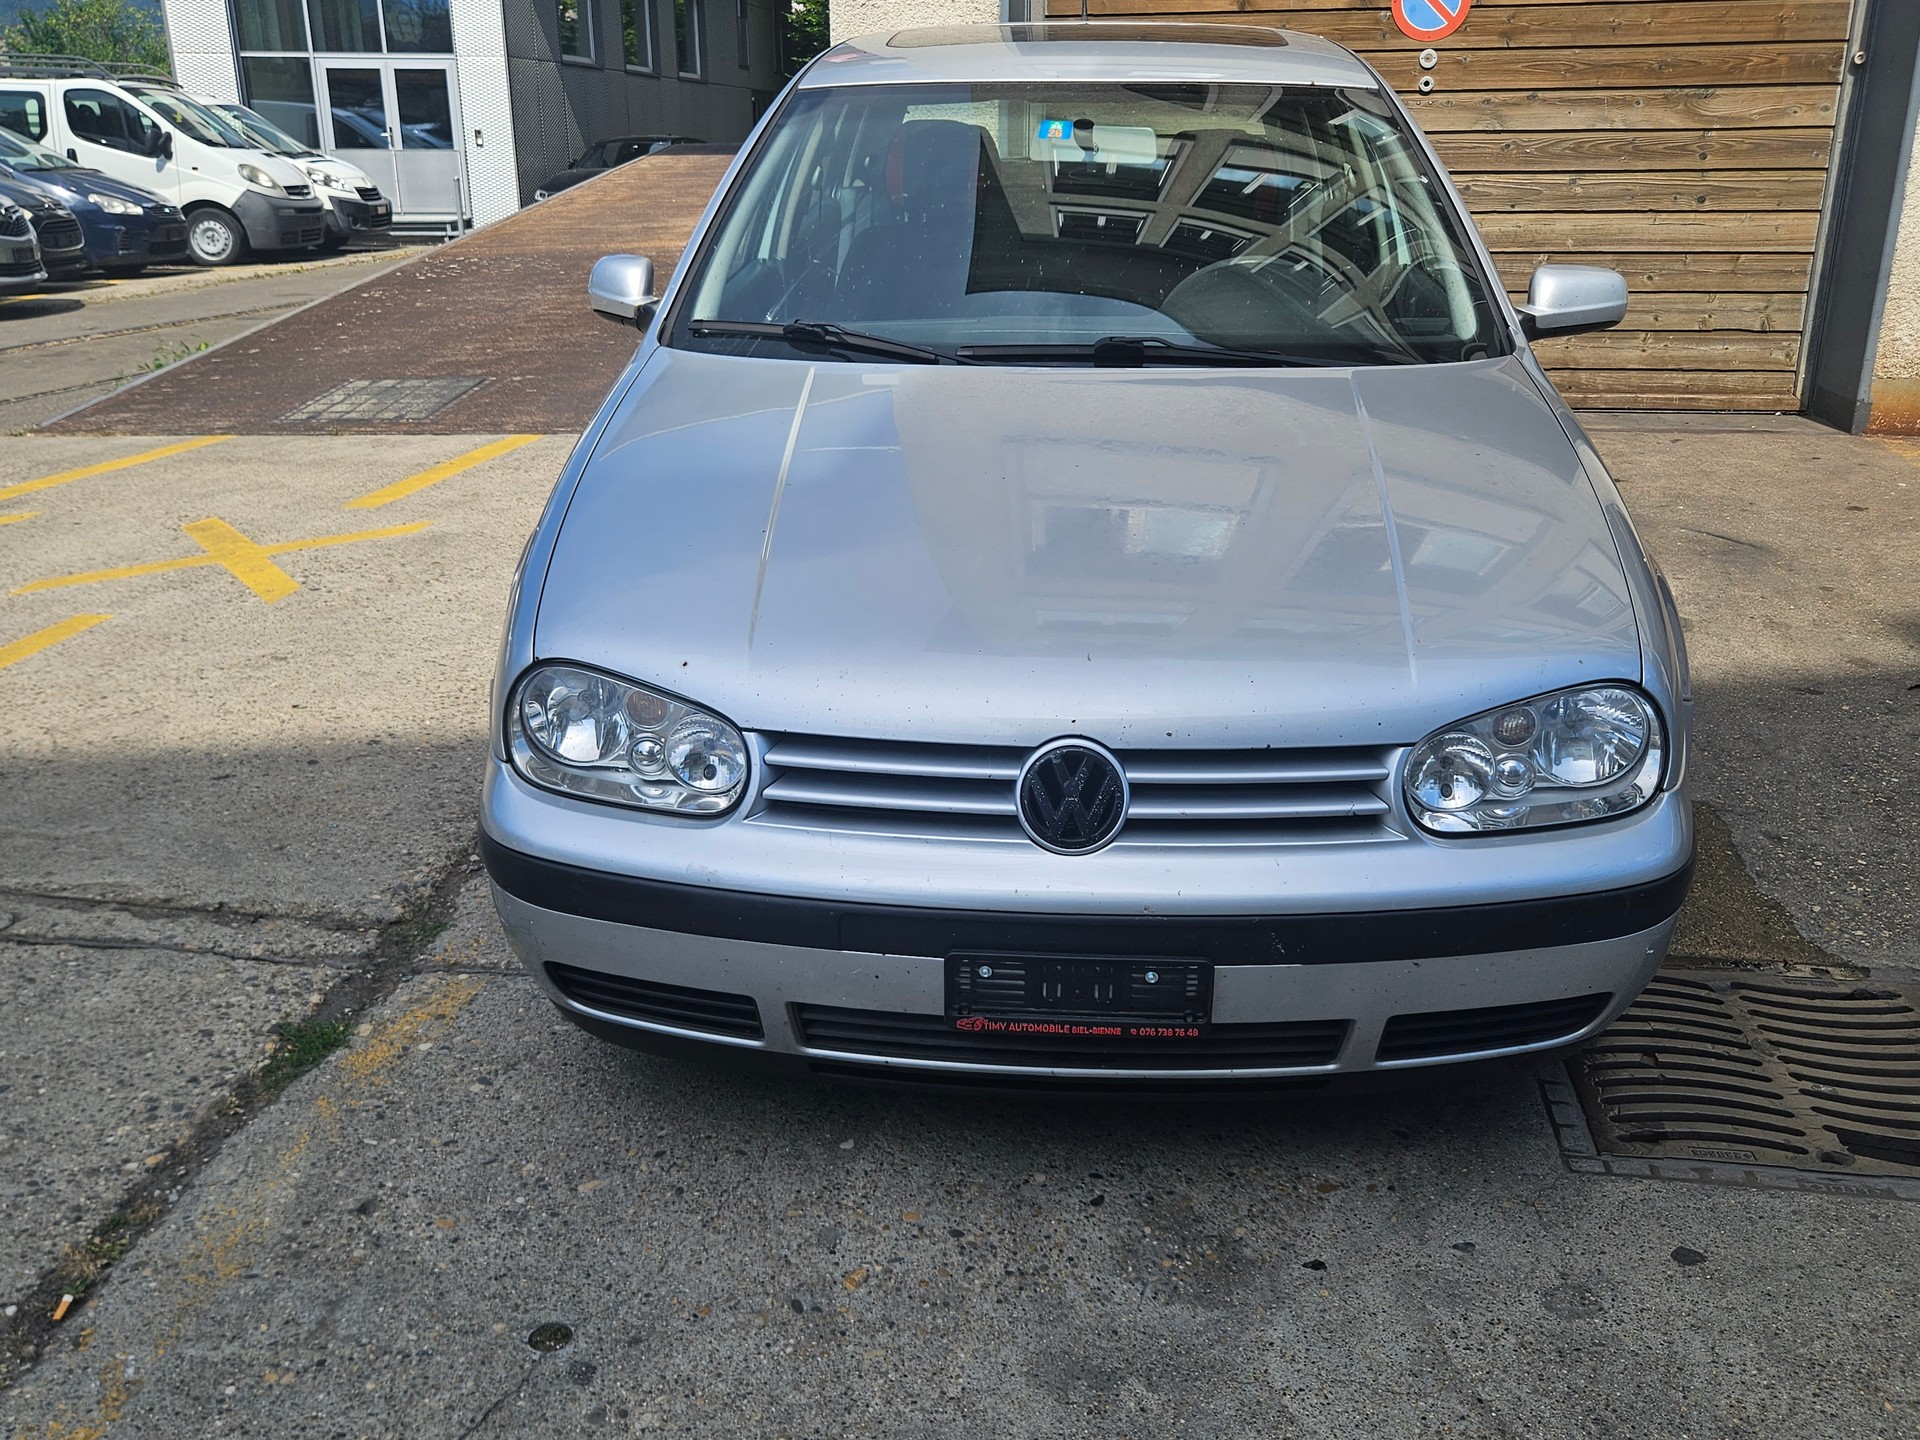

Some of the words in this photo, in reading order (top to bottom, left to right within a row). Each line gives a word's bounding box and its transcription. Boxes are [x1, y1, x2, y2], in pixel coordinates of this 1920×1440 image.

[1009, 1022, 1070, 1033] AUTOMOBILE
[1072, 1026, 1122, 1035] BIEL-BIENNE
[1139, 1027, 1156, 1036] 076
[1157, 1028, 1173, 1036] 738
[1175, 1028, 1185, 1037] 76
[1186, 1028, 1199, 1037] 48
